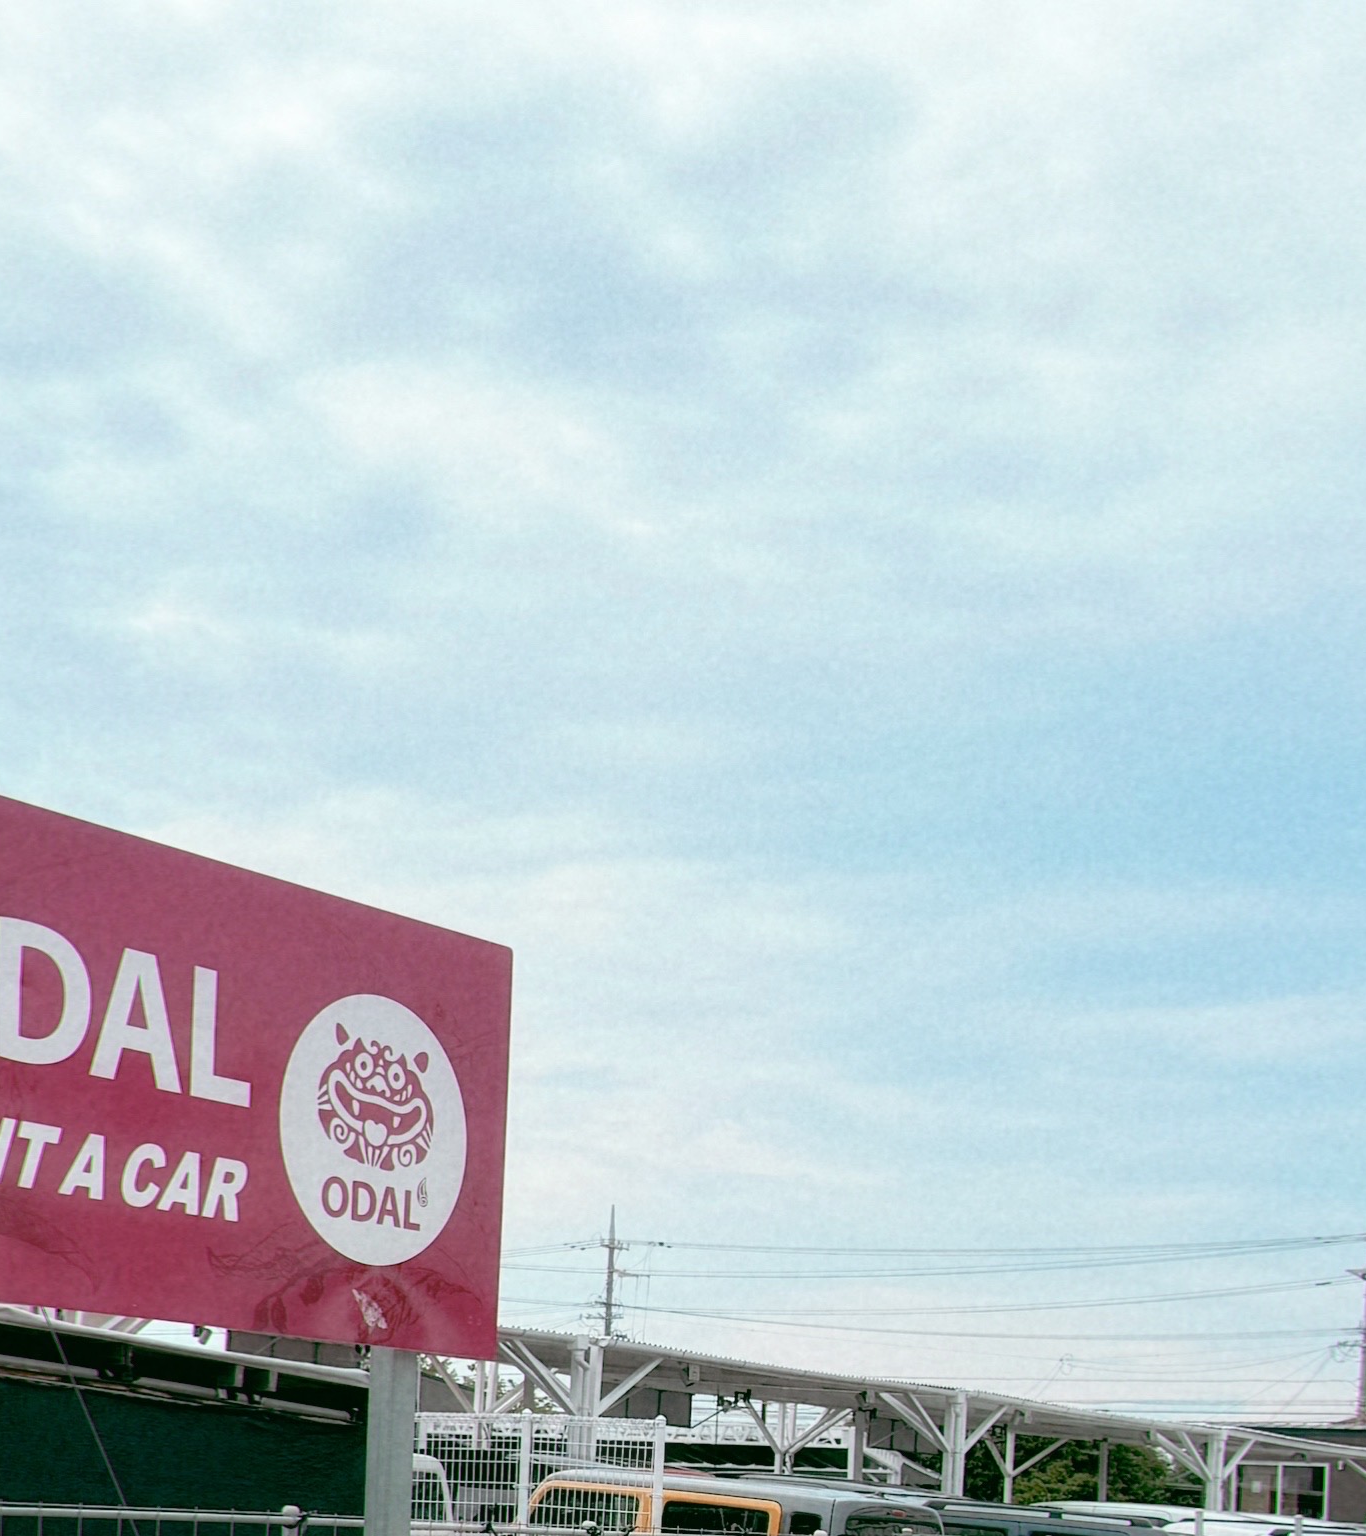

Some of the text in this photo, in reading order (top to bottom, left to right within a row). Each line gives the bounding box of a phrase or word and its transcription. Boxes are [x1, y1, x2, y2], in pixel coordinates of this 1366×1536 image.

[58, 1133, 106, 1201] A
[120, 1143, 248, 1222] CAR
[321, 1175, 421, 1232] ODAL
